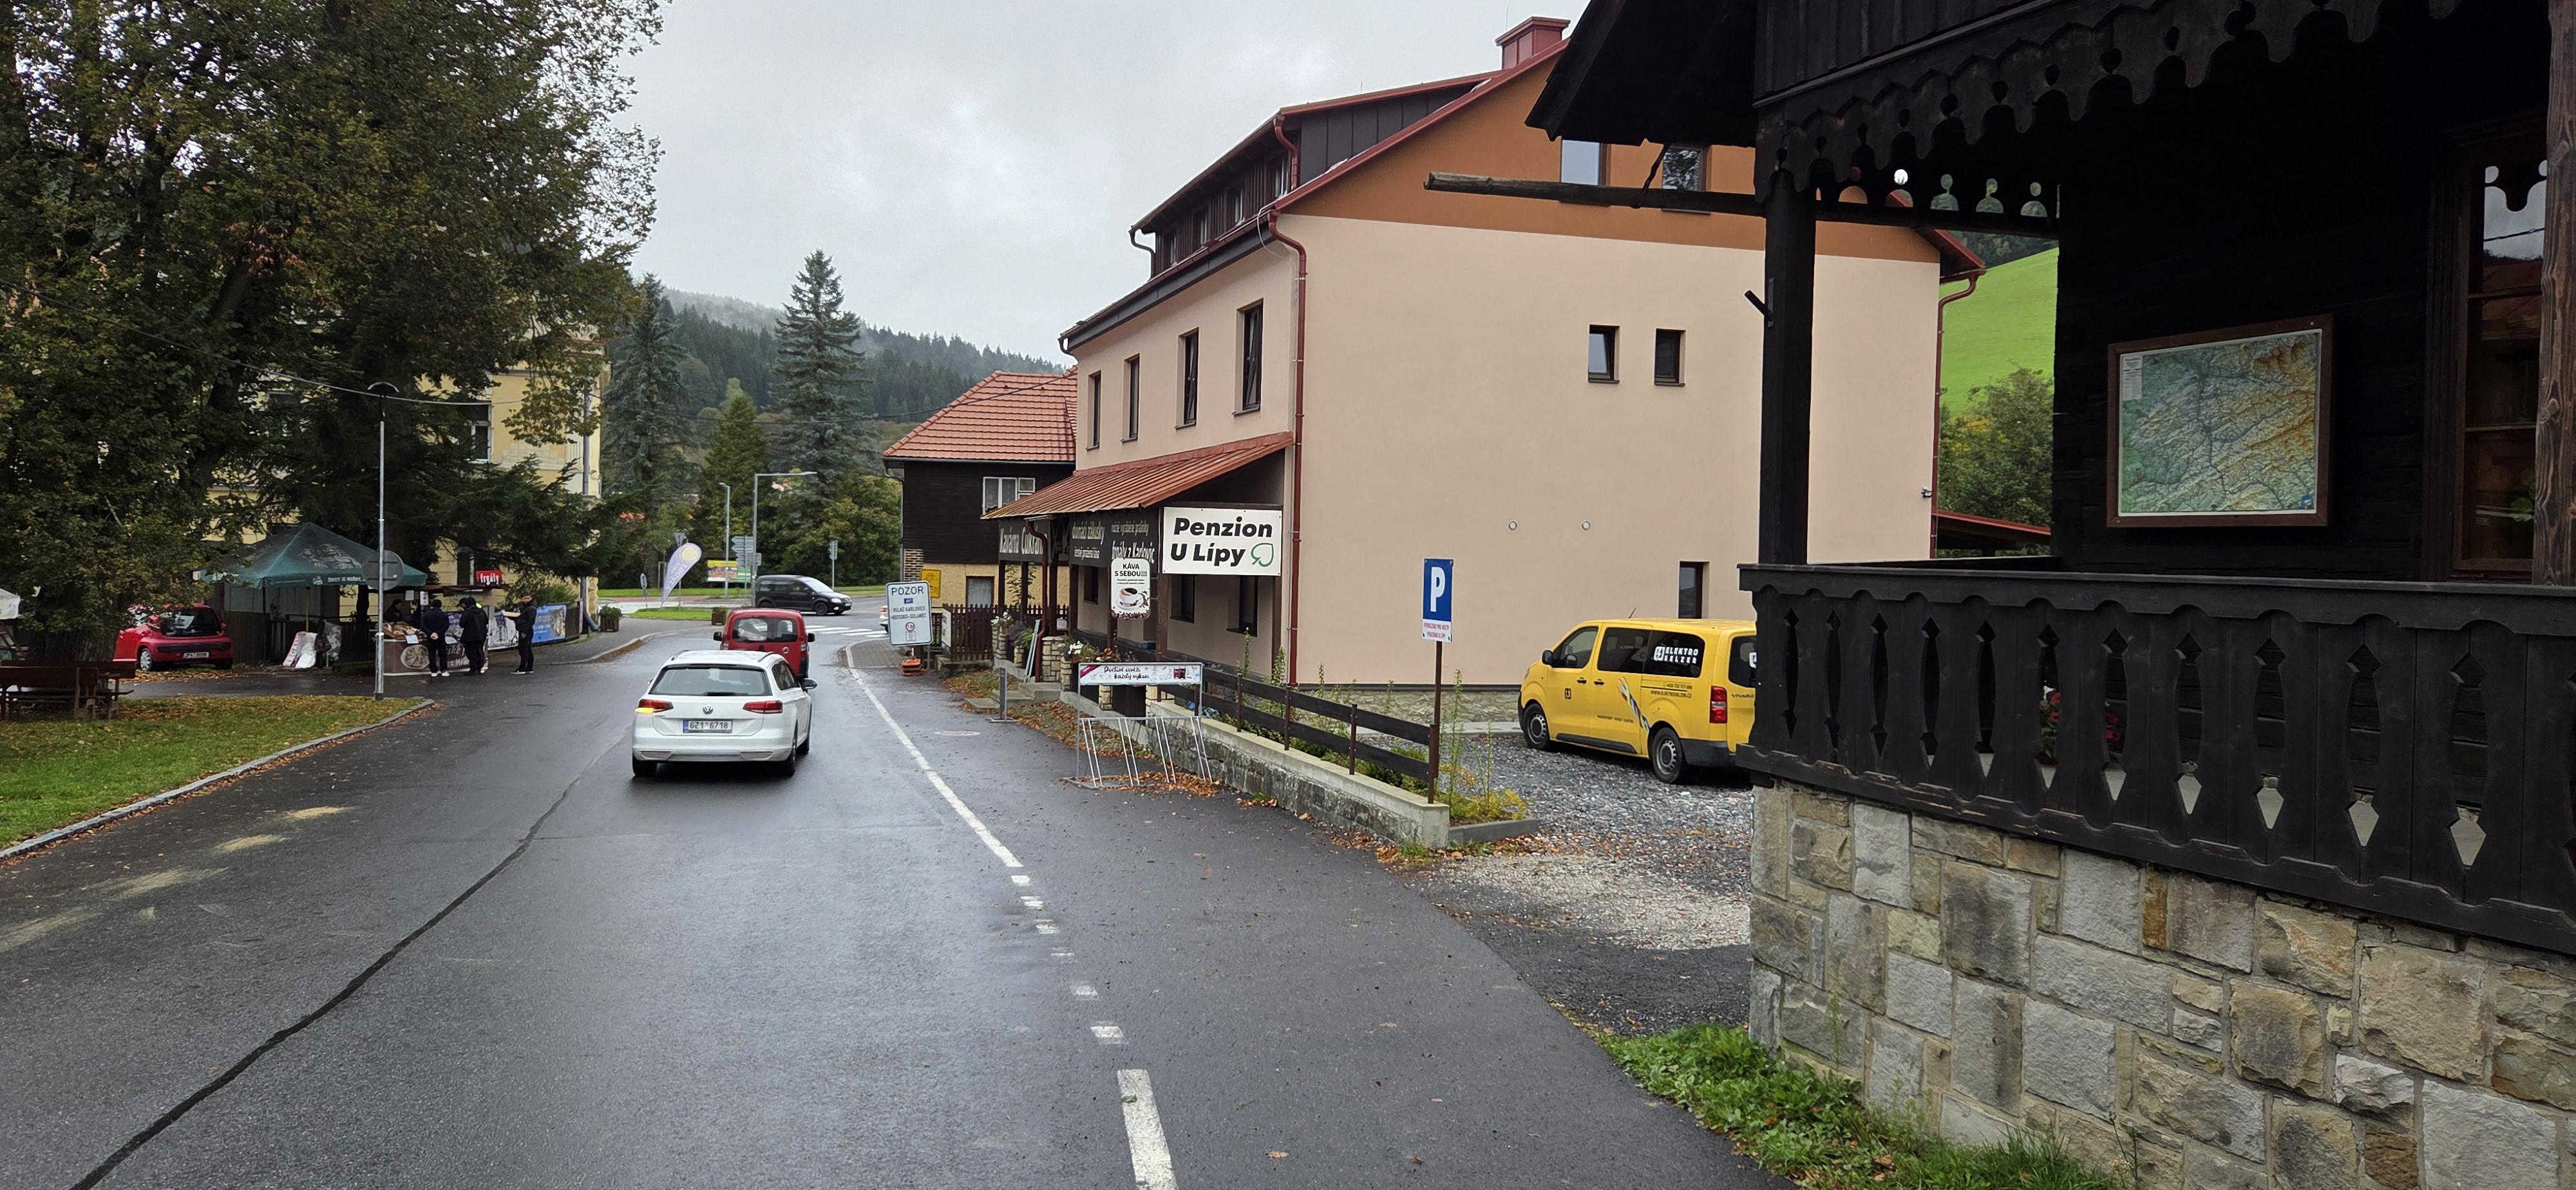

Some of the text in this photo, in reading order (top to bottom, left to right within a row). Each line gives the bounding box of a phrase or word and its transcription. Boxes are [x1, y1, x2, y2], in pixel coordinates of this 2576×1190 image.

[1173, 516, 1273, 538] Penzion
[1132, 542, 1155, 563] Karlovic
[1170, 543, 1246, 567] U Lípy
[480, 572, 500, 585] frgály
[891, 586, 924, 596] POZOR
[1430, 567, 1446, 612] P
[1664, 655, 1697, 664] SELZER
[1665, 647, 1699, 656] ELEKTRO
